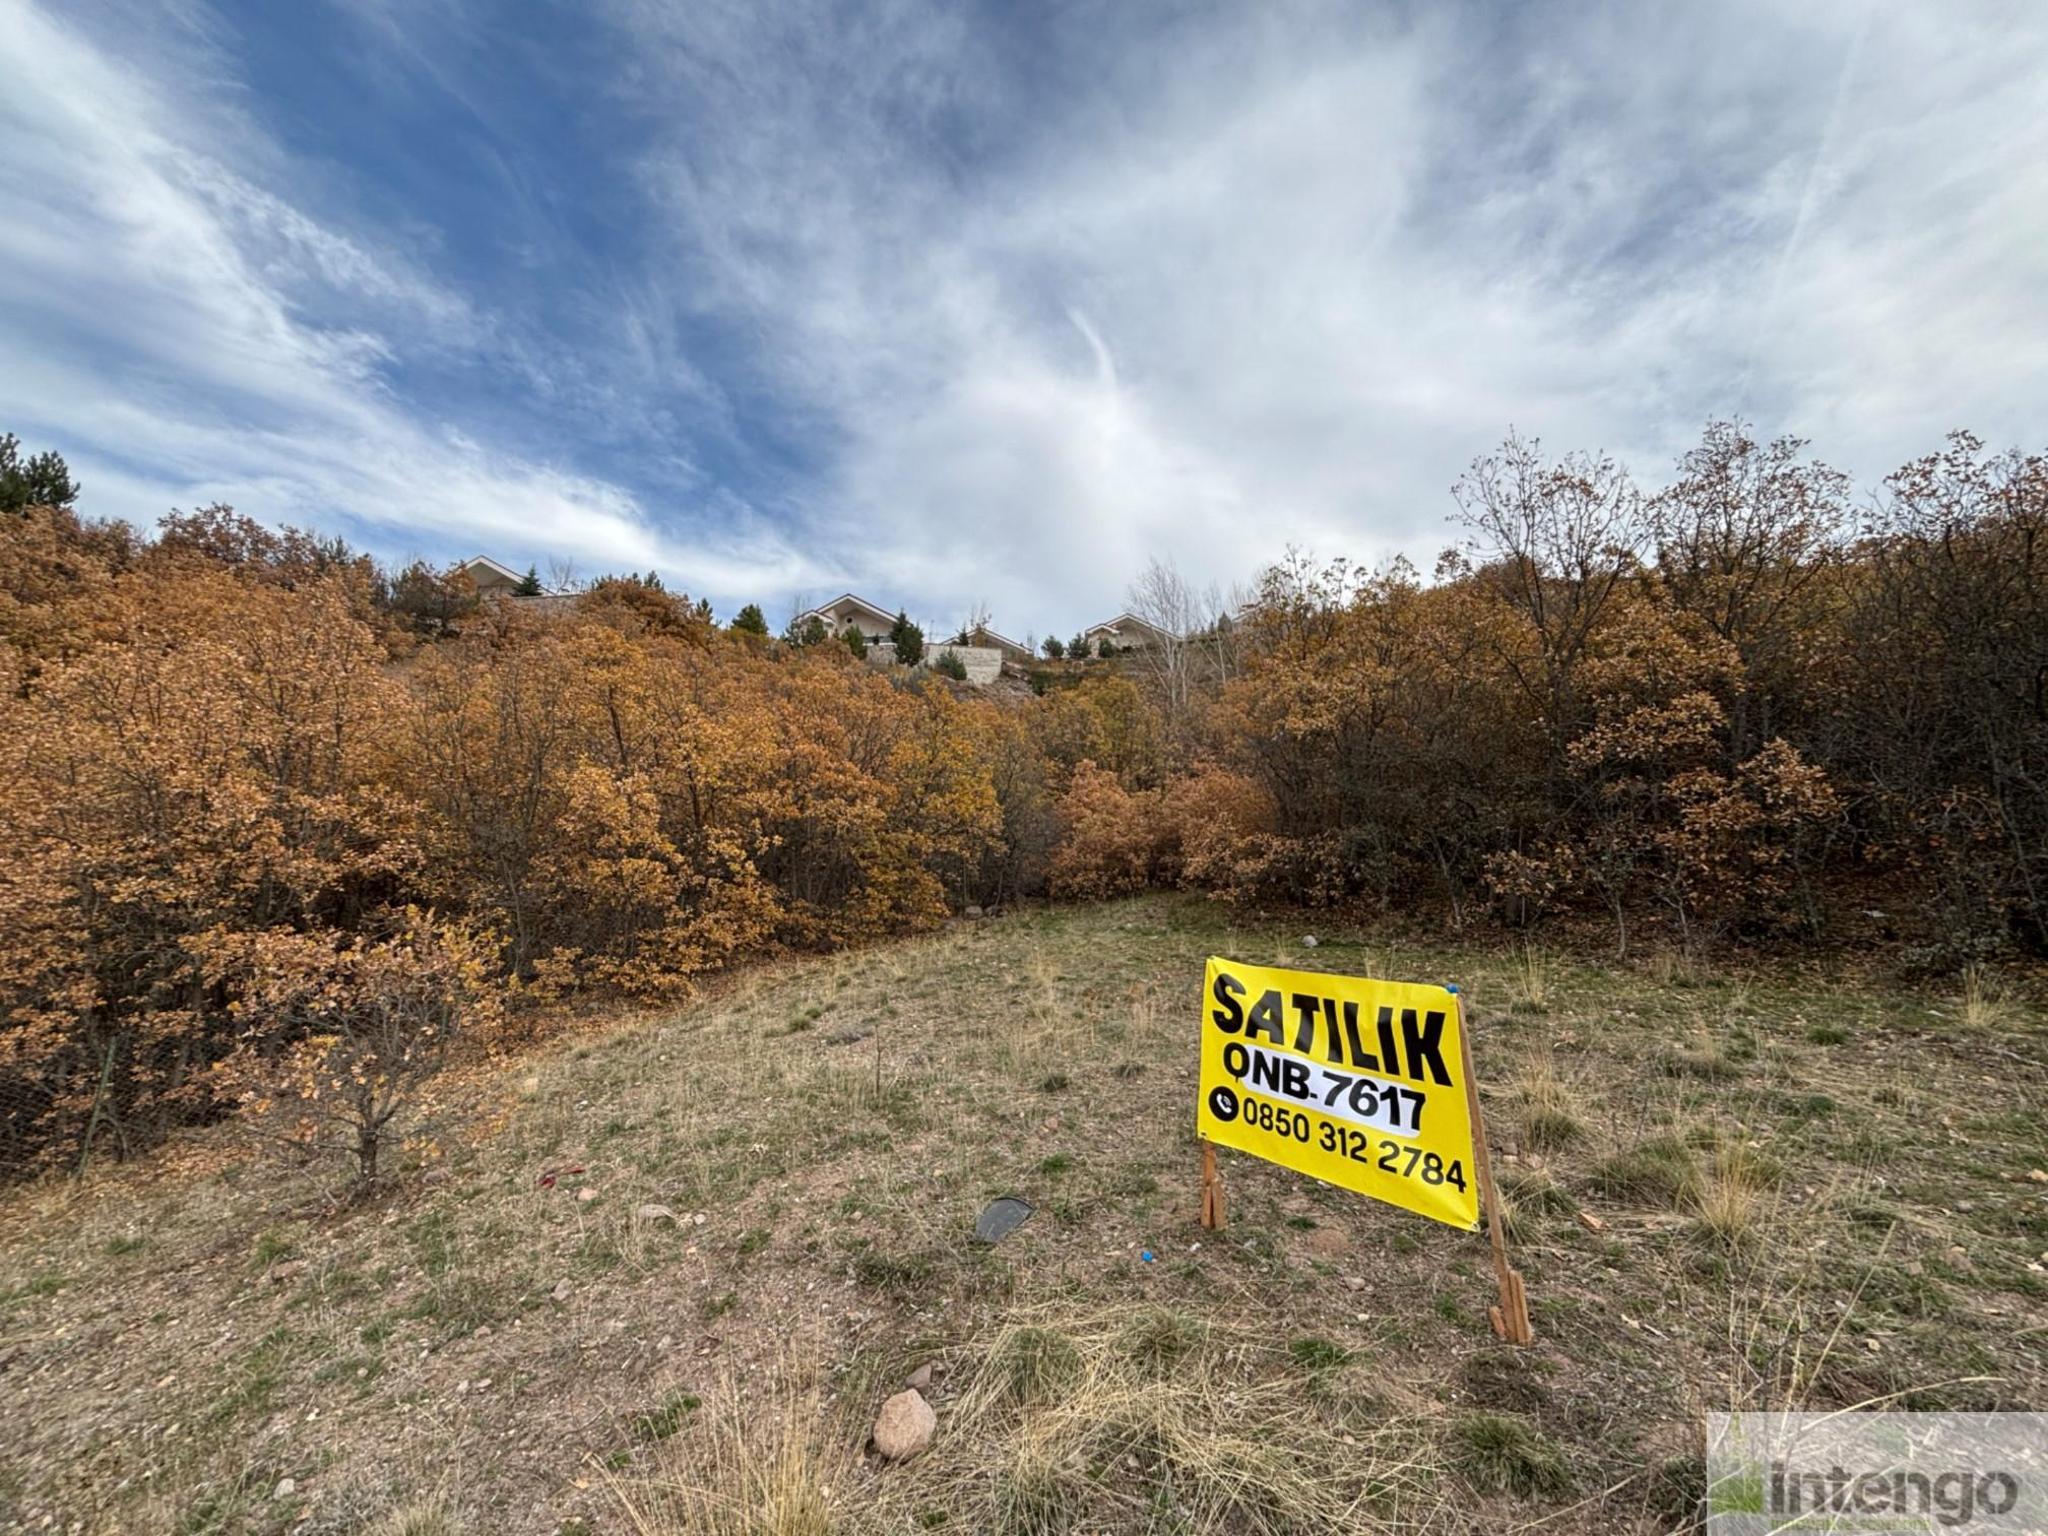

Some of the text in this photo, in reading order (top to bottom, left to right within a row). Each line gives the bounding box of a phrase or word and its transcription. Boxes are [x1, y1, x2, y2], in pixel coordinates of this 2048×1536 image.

[1212, 973, 1453, 1087] SATILIK
[1243, 1097, 1467, 1193] 0850 312 2784
